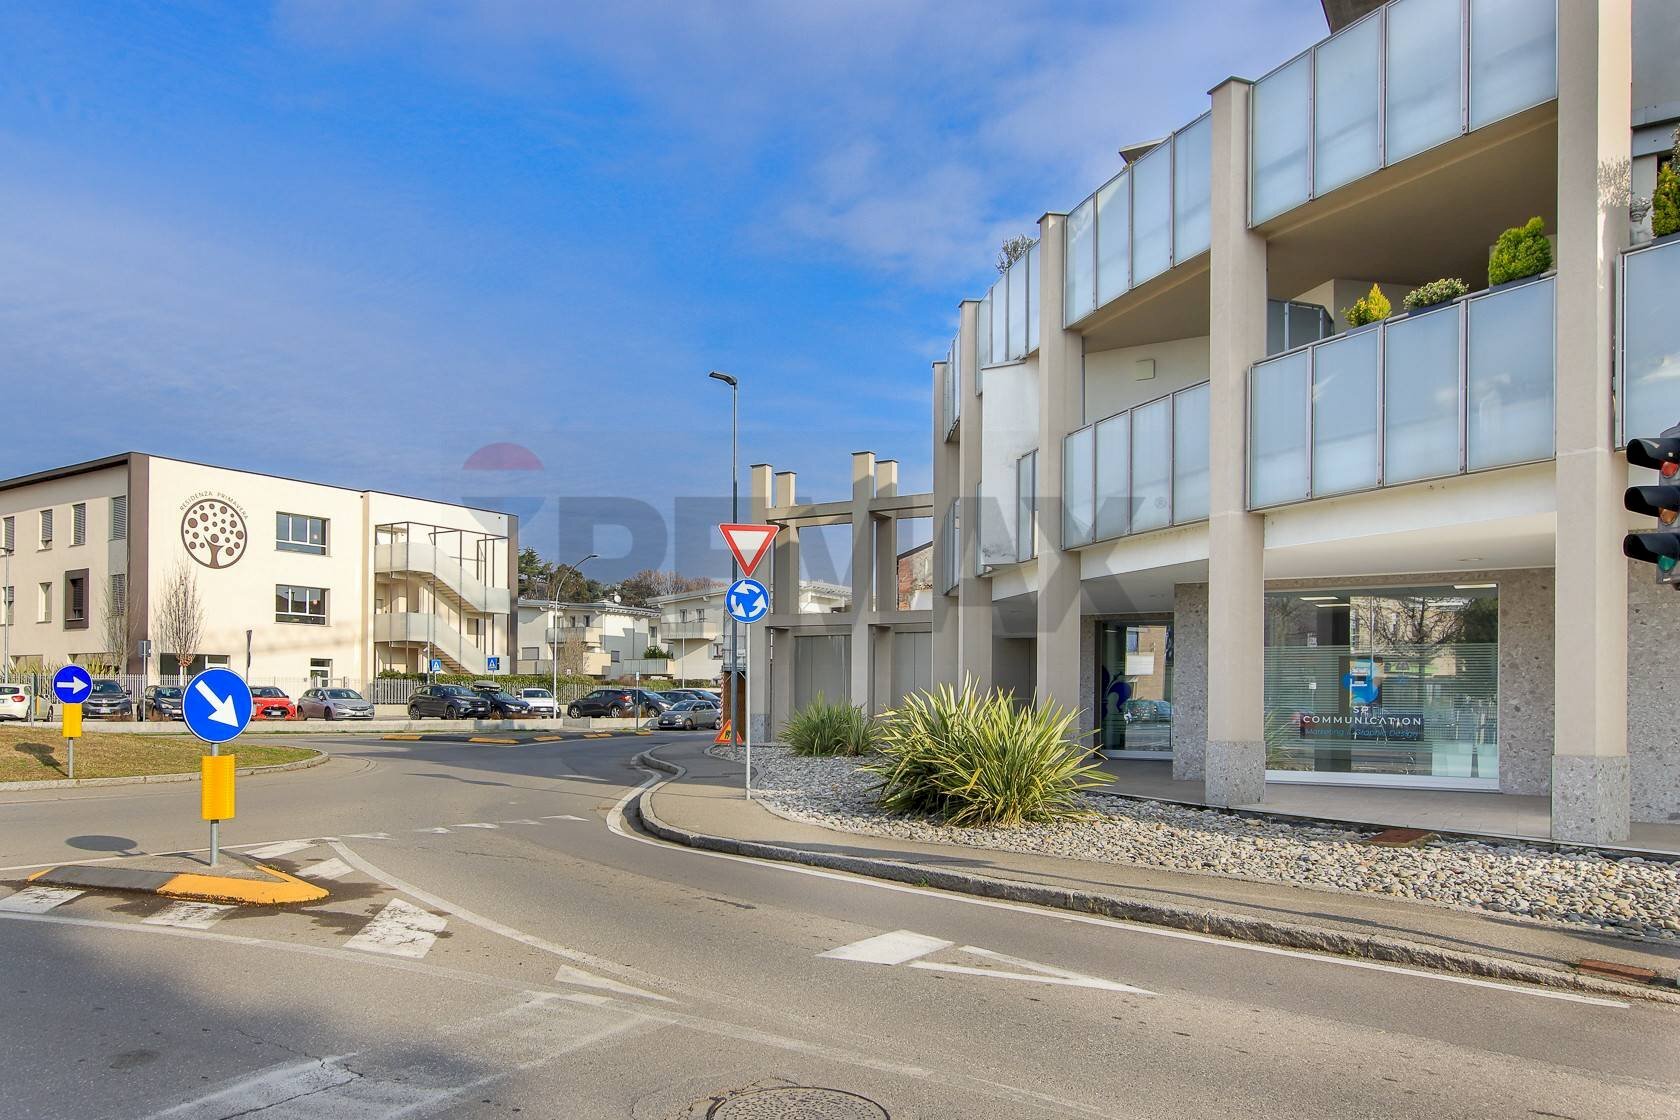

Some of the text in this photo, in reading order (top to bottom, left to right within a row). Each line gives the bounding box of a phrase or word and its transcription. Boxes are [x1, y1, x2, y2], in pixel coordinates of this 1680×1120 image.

[179, 490, 249, 520] RESIDENZA PRIMAVERA
[1302, 715, 1421, 726] COMMUNICATION
